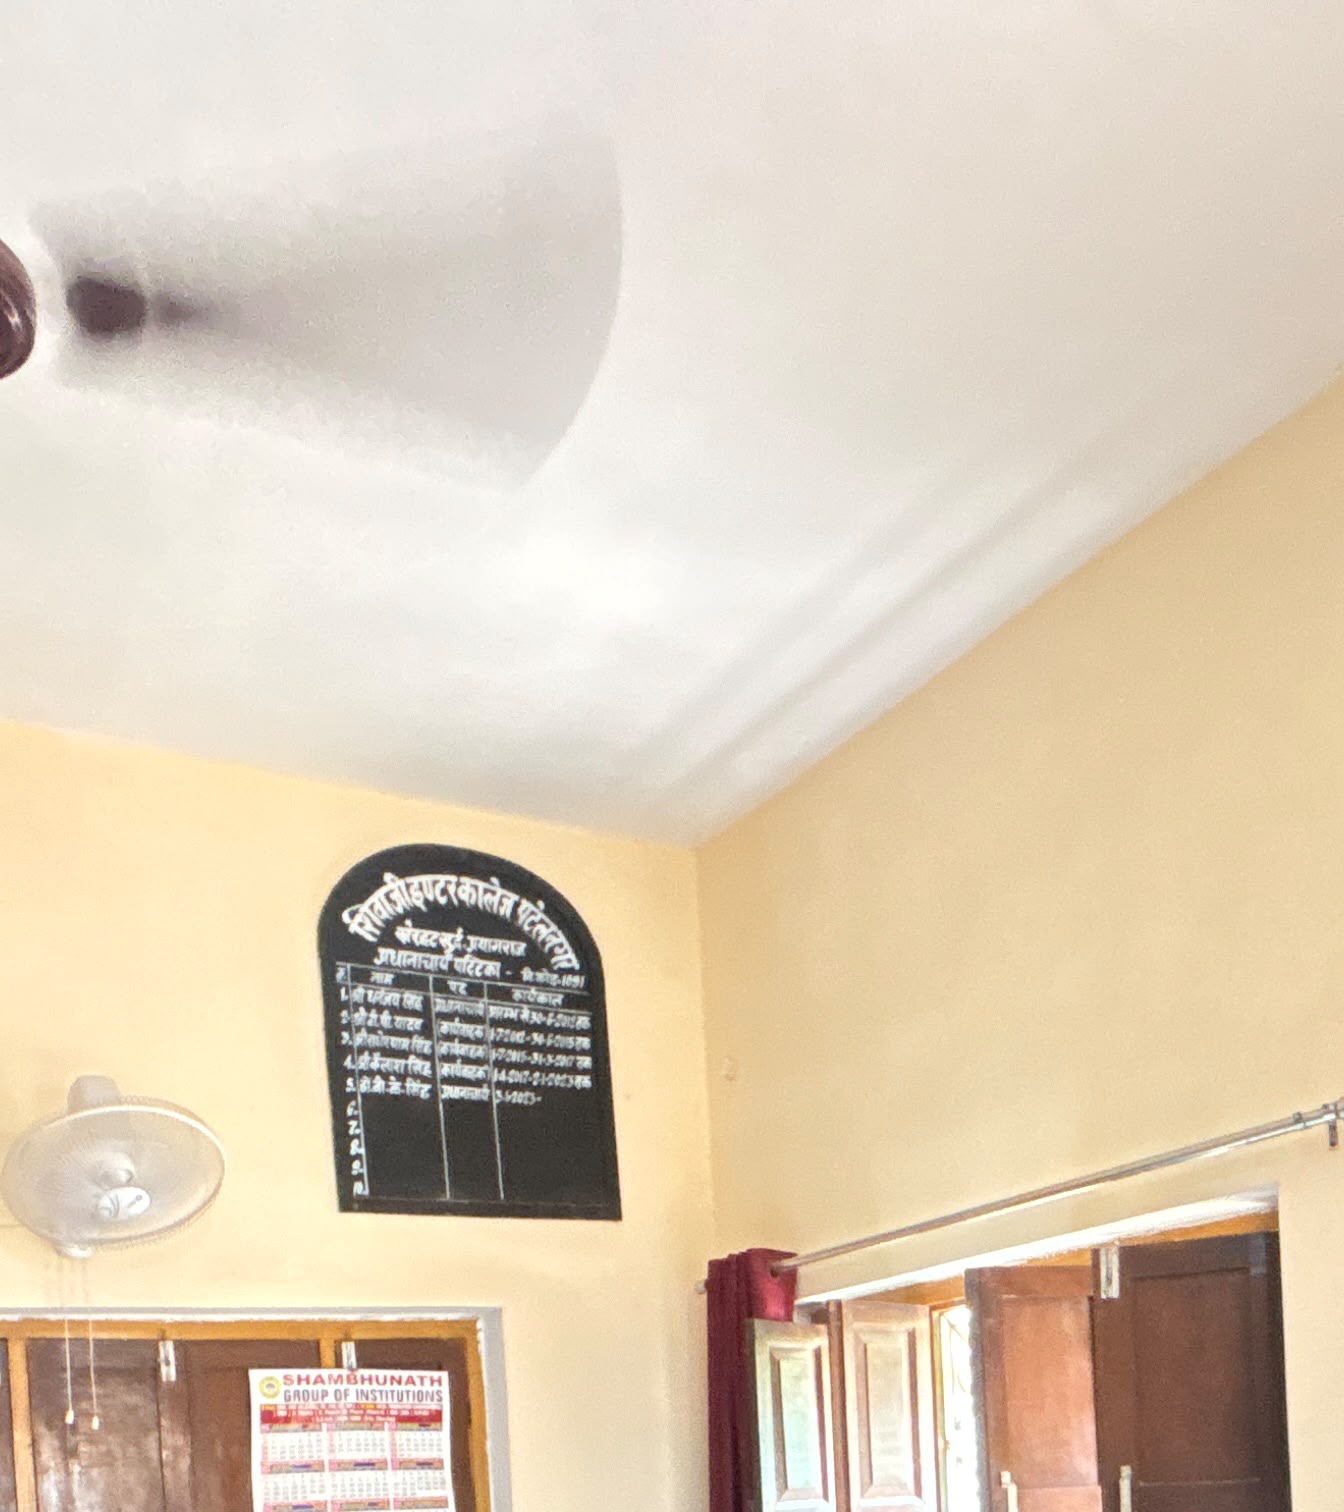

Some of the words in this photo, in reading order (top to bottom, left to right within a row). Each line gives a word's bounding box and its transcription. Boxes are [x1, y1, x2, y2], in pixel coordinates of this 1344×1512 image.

[456, 876, 519, 921] कालेज
[466, 934, 527, 957] प्रयागराज
[511, 987, 565, 1007] कार्यकाल
[282, 1374, 444, 1387] SHAMBHUNATH
[283, 1388, 329, 1403] GROUP
[334, 1388, 351, 1402] OF
[355, 1388, 444, 1403] INSTITUTIONS
